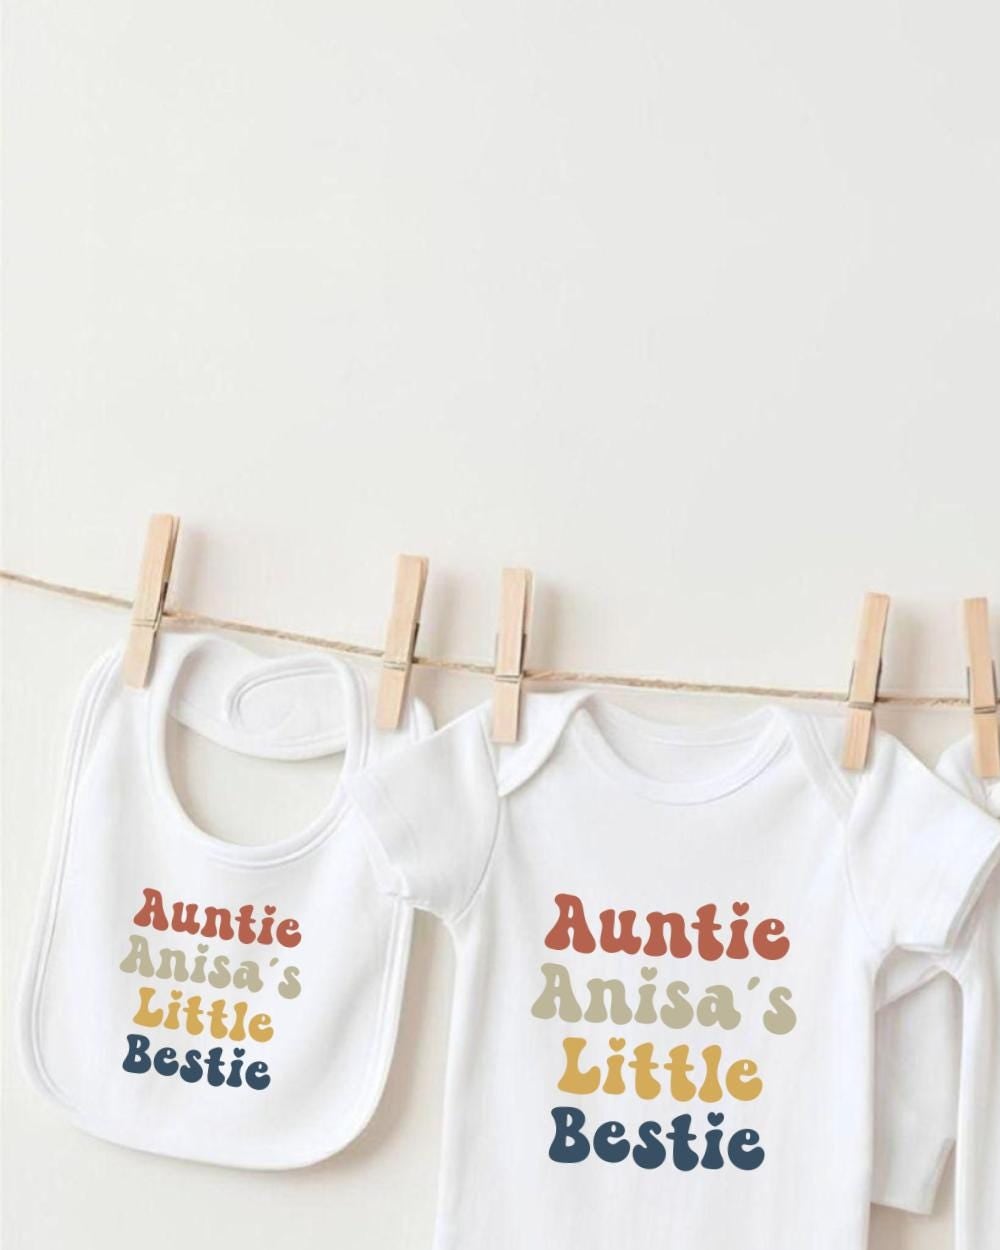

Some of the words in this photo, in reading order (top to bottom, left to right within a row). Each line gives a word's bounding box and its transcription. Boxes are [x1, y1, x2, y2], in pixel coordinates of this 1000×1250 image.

[133, 888, 302, 948] Auntie
[544, 893, 790, 961] Auntie
[132, 986, 274, 1043] Little
[122, 1033, 270, 1091] Bestie
[557, 1037, 762, 1102] Little
[549, 1106, 764, 1171] Bestie
